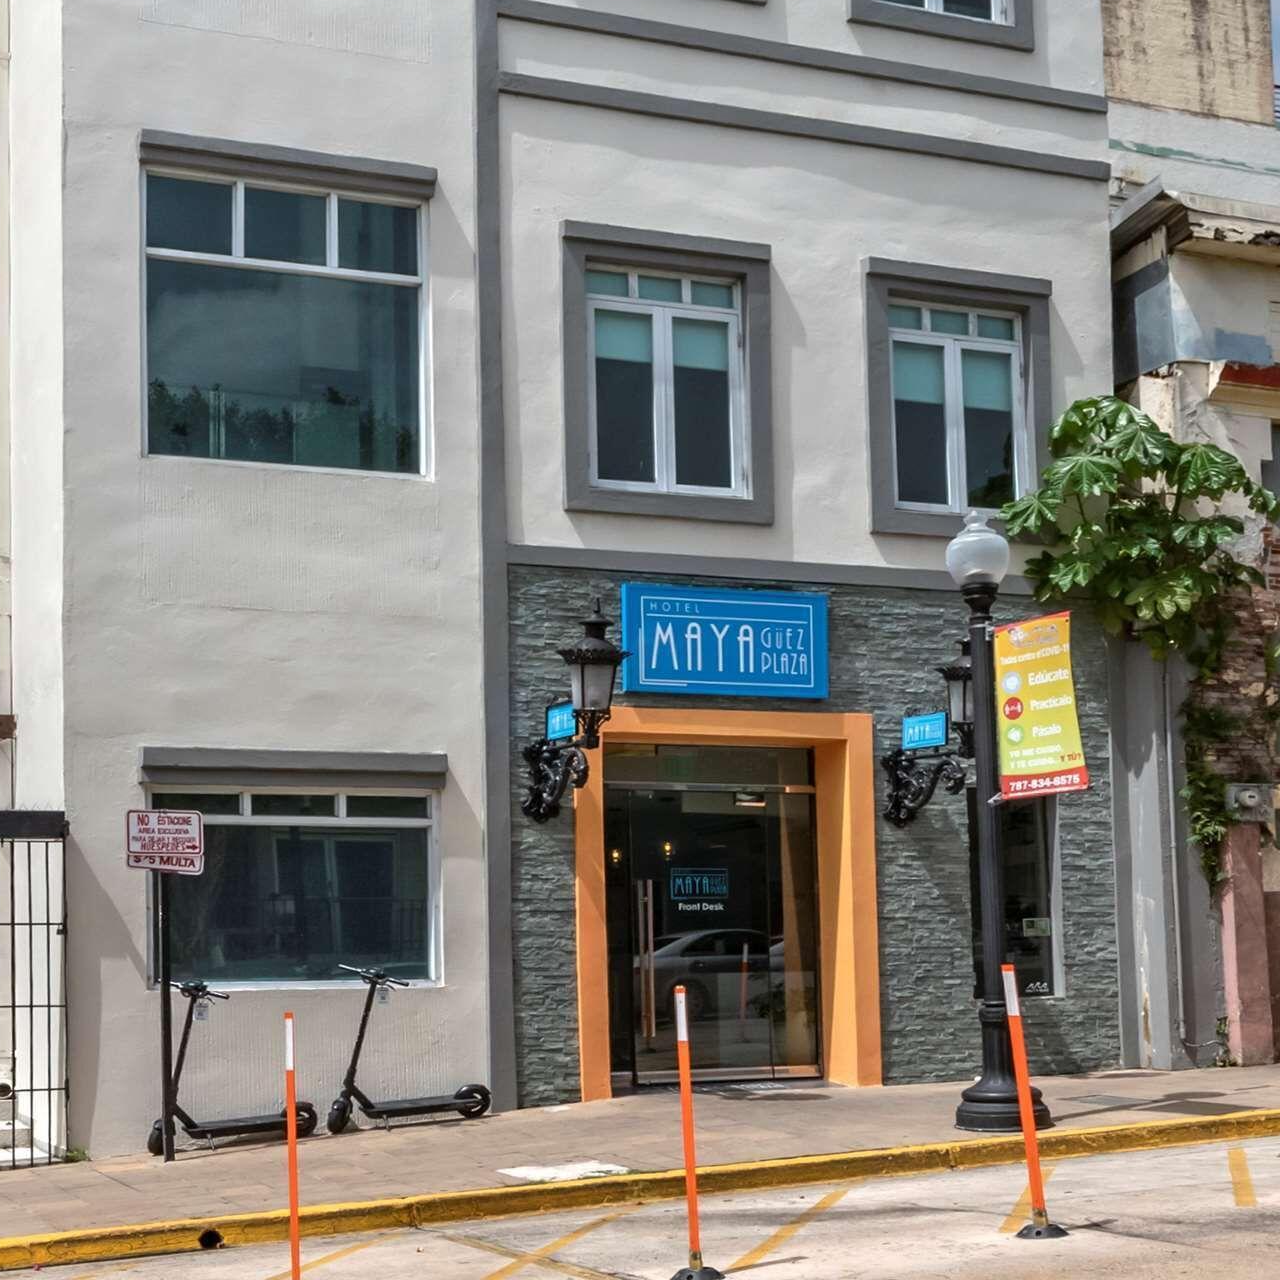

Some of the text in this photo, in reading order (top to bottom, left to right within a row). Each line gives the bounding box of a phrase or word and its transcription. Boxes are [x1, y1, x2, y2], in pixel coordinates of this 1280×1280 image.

[649, 601, 700, 614] HOTEL
[651, 621, 805, 673] MAYA GÜEZ
[761, 652, 808, 675] PLAZA
[1028, 669, 1069, 686] Edúcate
[137, 814, 193, 826] NO ESTACIONE
[160, 856, 196, 868] MULTA
[675, 876, 710, 895] MAYA
[678, 903, 725, 911] Front Desk
